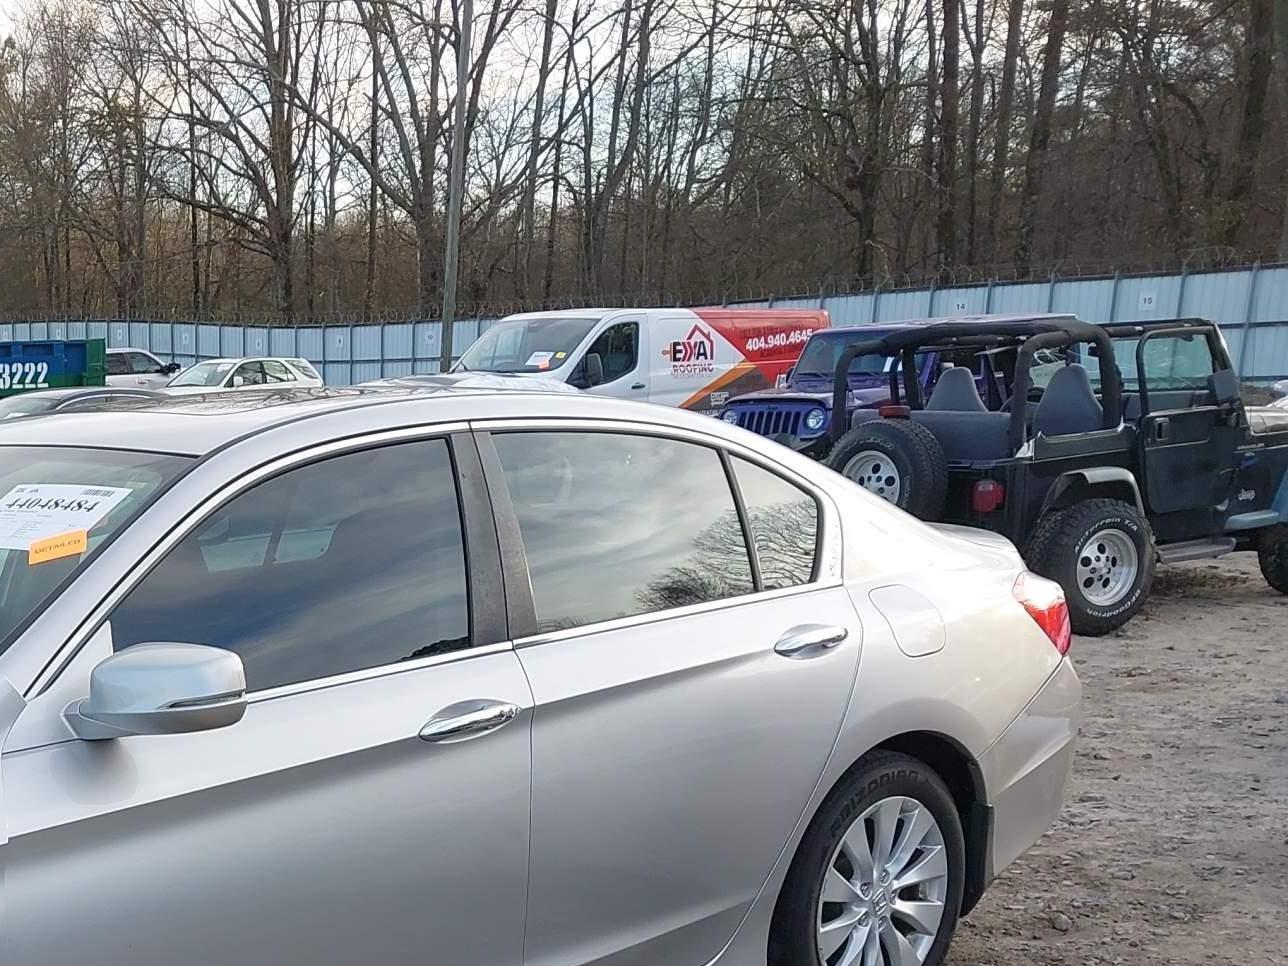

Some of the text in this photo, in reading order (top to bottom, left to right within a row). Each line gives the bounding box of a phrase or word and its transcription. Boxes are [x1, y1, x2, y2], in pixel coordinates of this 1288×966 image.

[956, 303, 965, 311] 14
[745, 328, 813, 352] 404.940.4645
[672, 363, 714, 374] ROOFING
[1237, 488, 1256, 502] Jeep
[5, 496, 101, 513] 44048484
[1124, 518, 1139, 533] T/A
[34, 538, 82, 555] DETAILED
[1086, 588, 1142, 619] BFGoodrich
